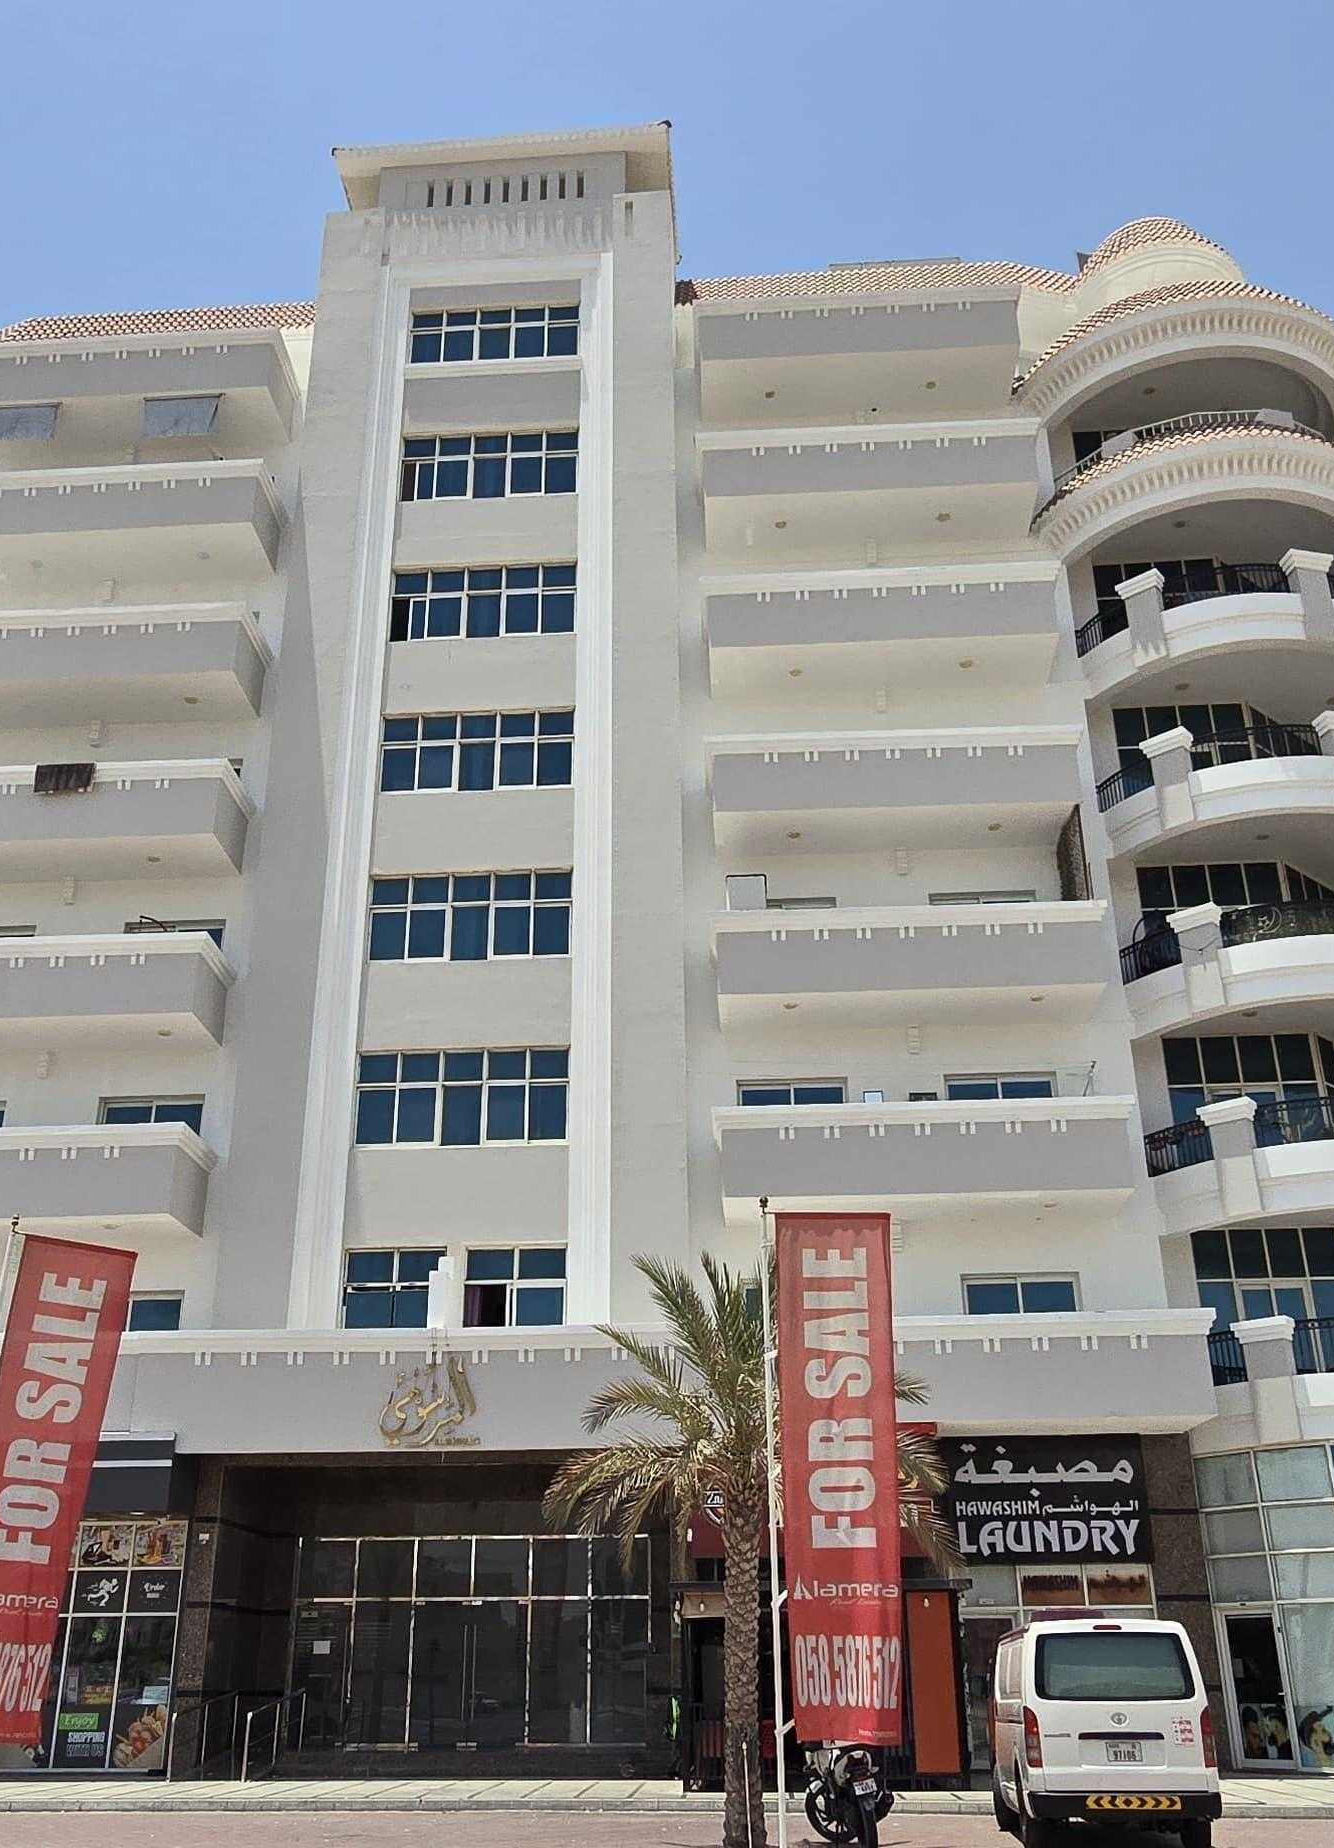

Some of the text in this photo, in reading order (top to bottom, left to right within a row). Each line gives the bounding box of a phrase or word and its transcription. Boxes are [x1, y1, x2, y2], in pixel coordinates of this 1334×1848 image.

[15, 1272, 107, 1424] SALE
[803, 1248, 877, 1549] FOR SALE
[954, 1443, 1134, 1497] مصبغة
[956, 1500, 1040, 1517] HAWASHIM
[957, 1519, 1140, 1556] LAUNDRY
[793, 1575, 899, 1600] Alamera
[21, 1643, 52, 1712] 512
[795, 1633, 901, 1710] 058 5876 512
[67, 1731, 106, 1743] SHOPPING
